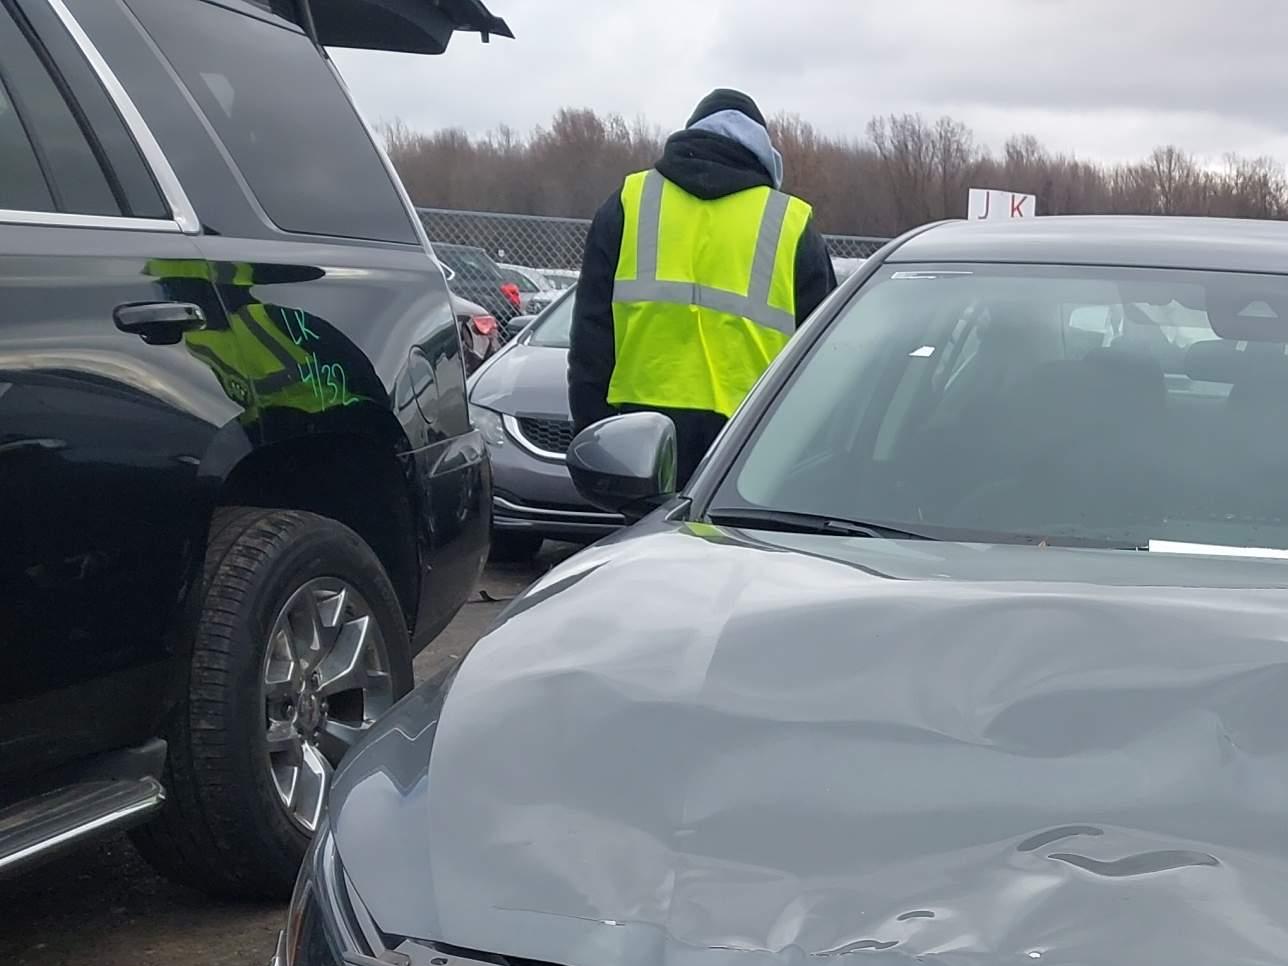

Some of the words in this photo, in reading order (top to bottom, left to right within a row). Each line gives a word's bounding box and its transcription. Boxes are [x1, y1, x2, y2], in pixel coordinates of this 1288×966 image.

[978, 191, 990, 219] J
[1010, 194, 1028, 218] K
[297, 352, 359, 411] 4/32
